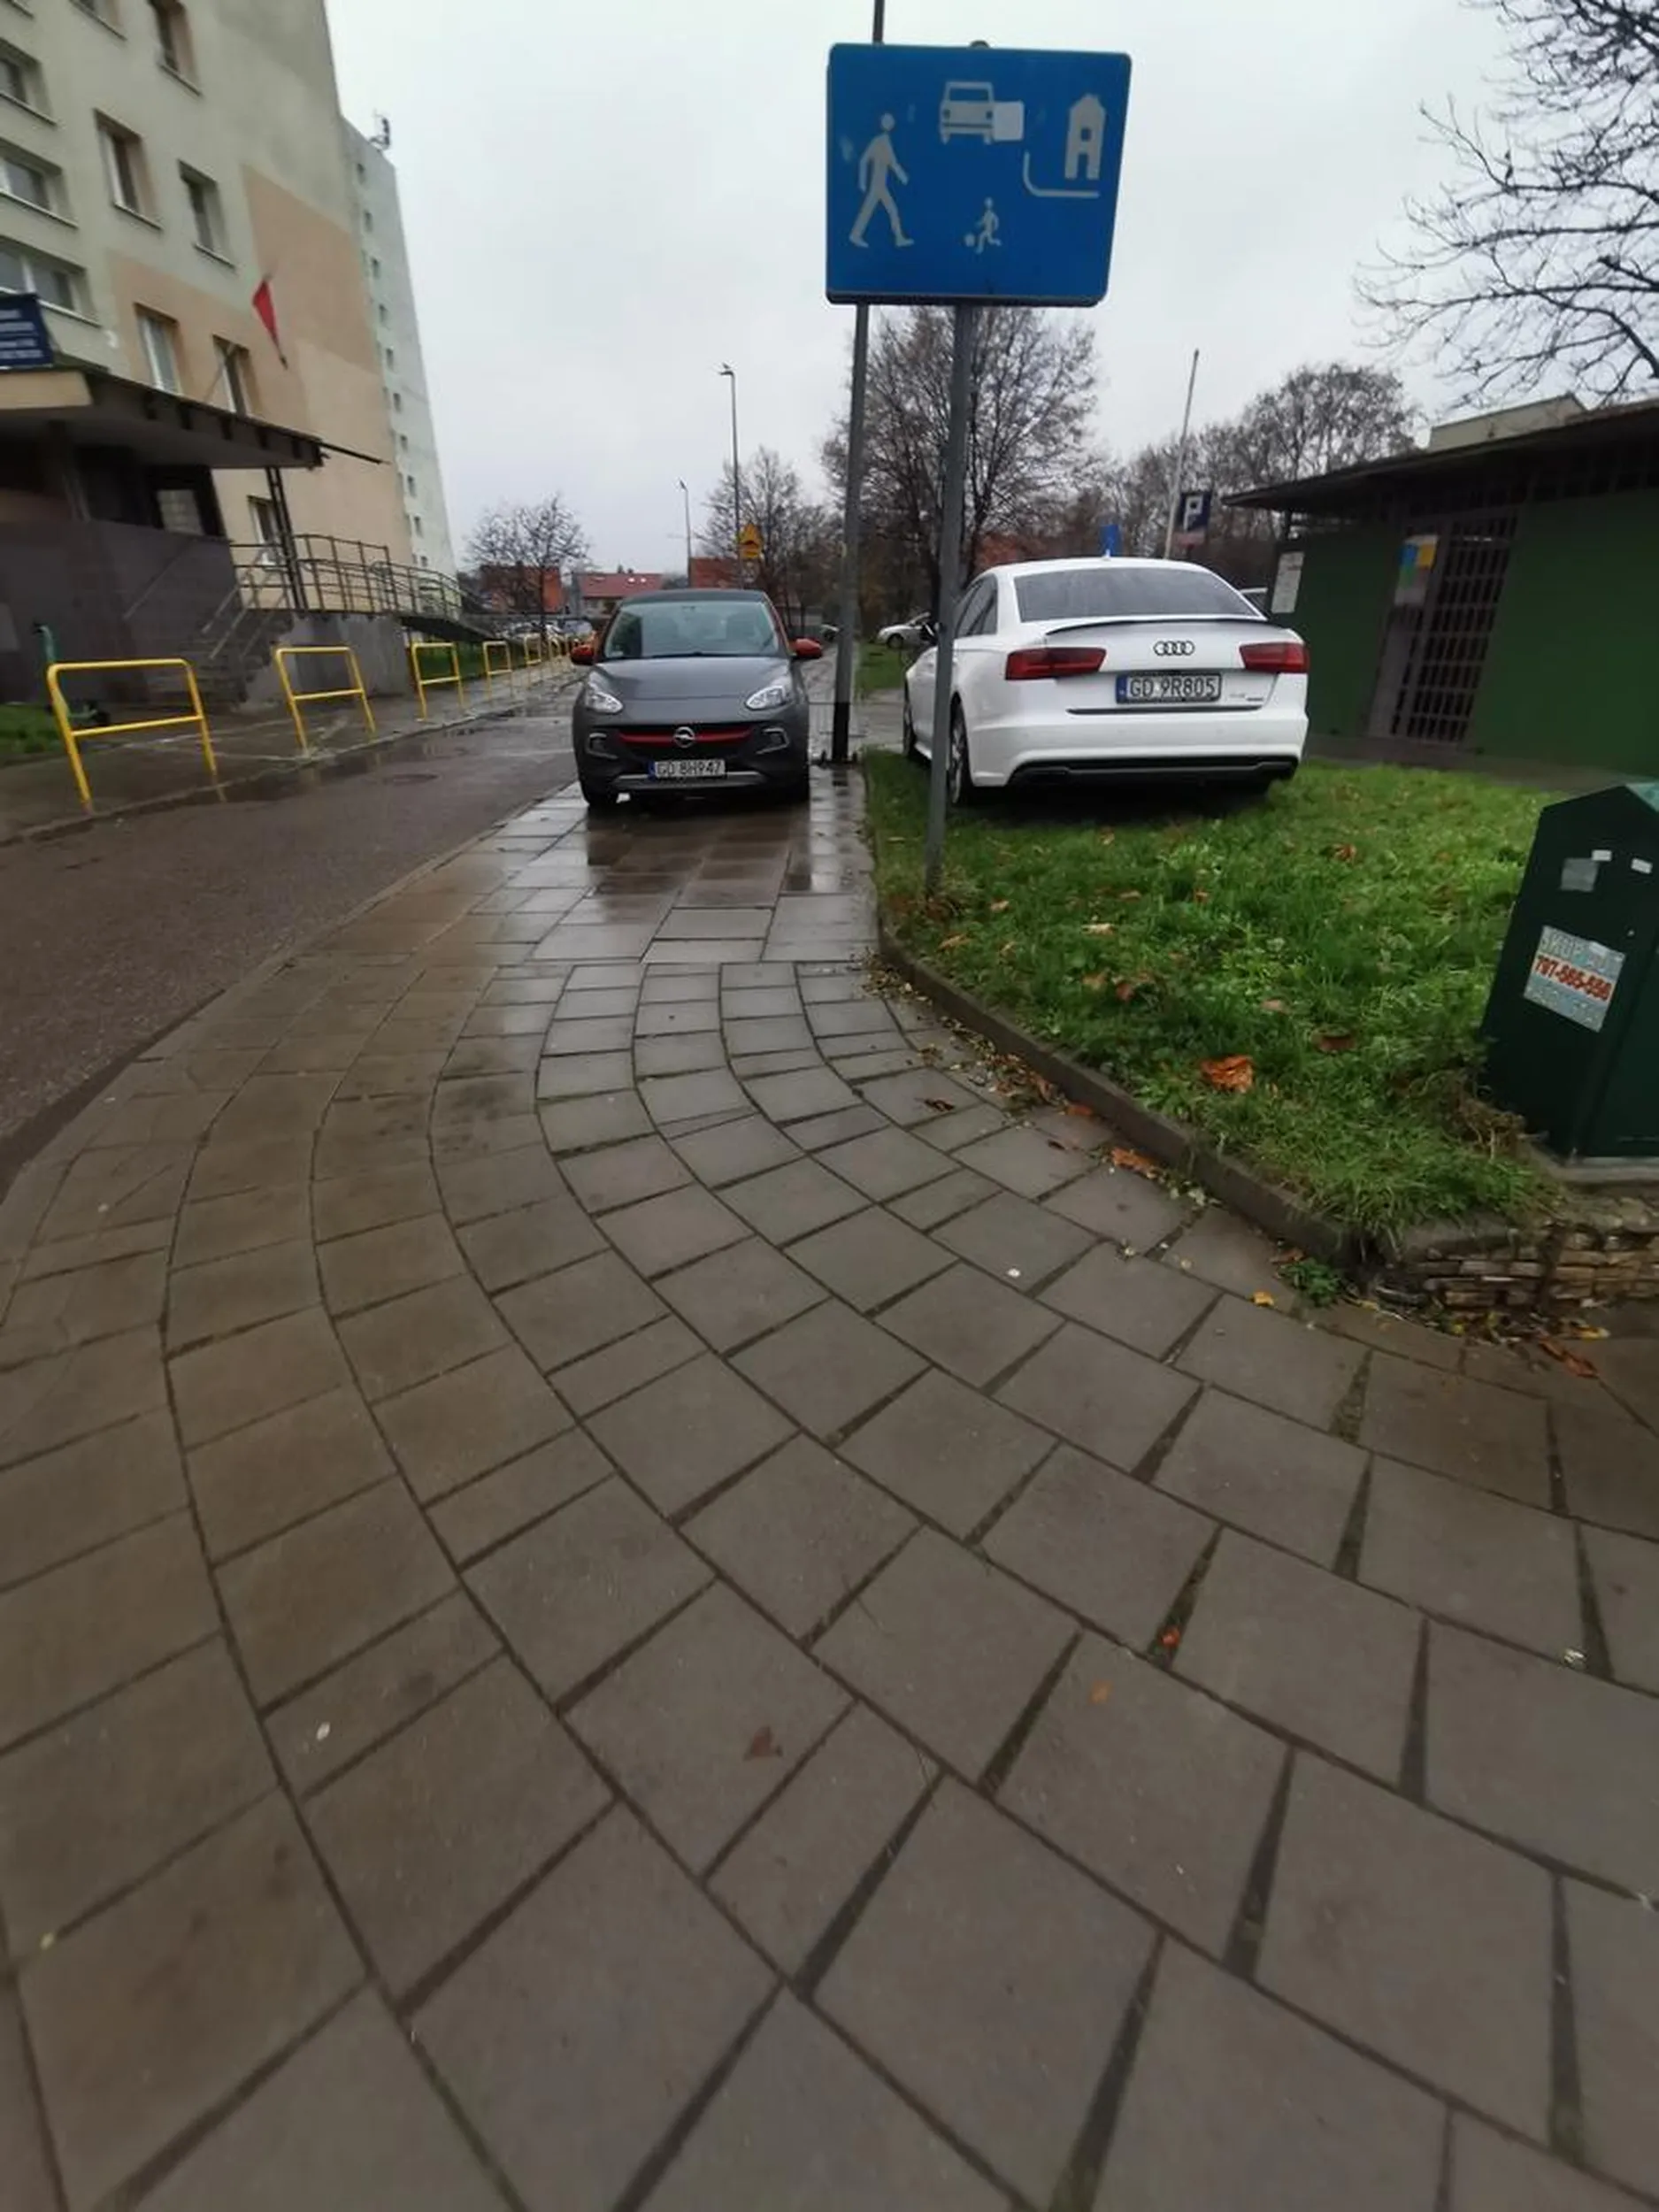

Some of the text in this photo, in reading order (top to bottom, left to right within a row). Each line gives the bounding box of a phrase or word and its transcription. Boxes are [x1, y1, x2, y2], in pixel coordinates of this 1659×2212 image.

[1183, 495, 1203, 530] P
[1130, 678, 1154, 697] GD
[1160, 677, 1217, 697] 9R805
